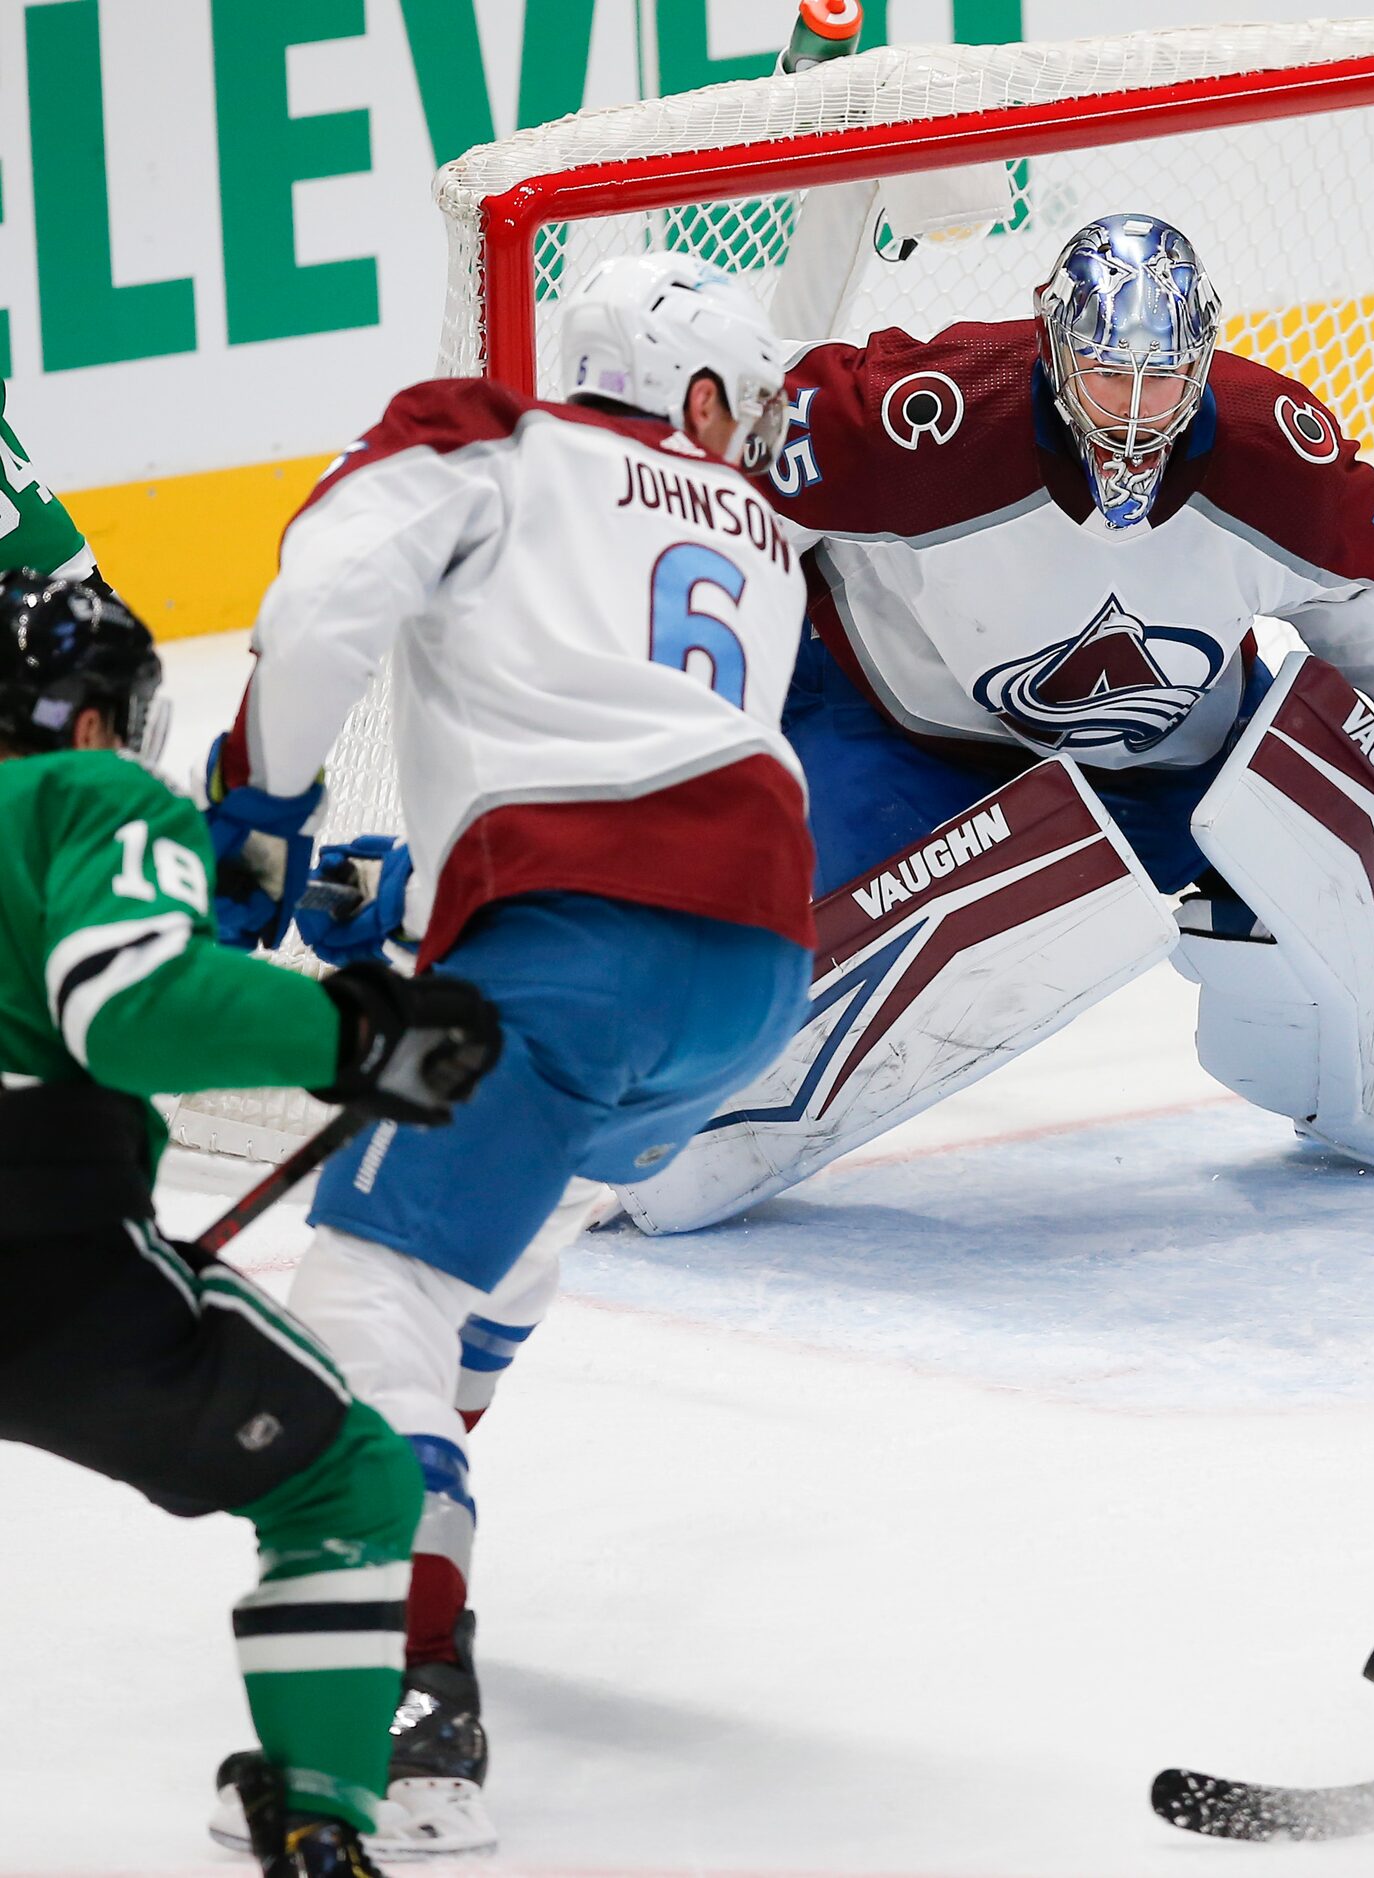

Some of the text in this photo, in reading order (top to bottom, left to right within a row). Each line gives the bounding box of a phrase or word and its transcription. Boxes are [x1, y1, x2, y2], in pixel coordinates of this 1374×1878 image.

[617, 456, 791, 574] JOHNSON
[1102, 459, 1155, 520] 35
[649, 541, 746, 708] 6
[112, 818, 209, 918] 18
[851, 802, 1012, 920] VAUGHN
